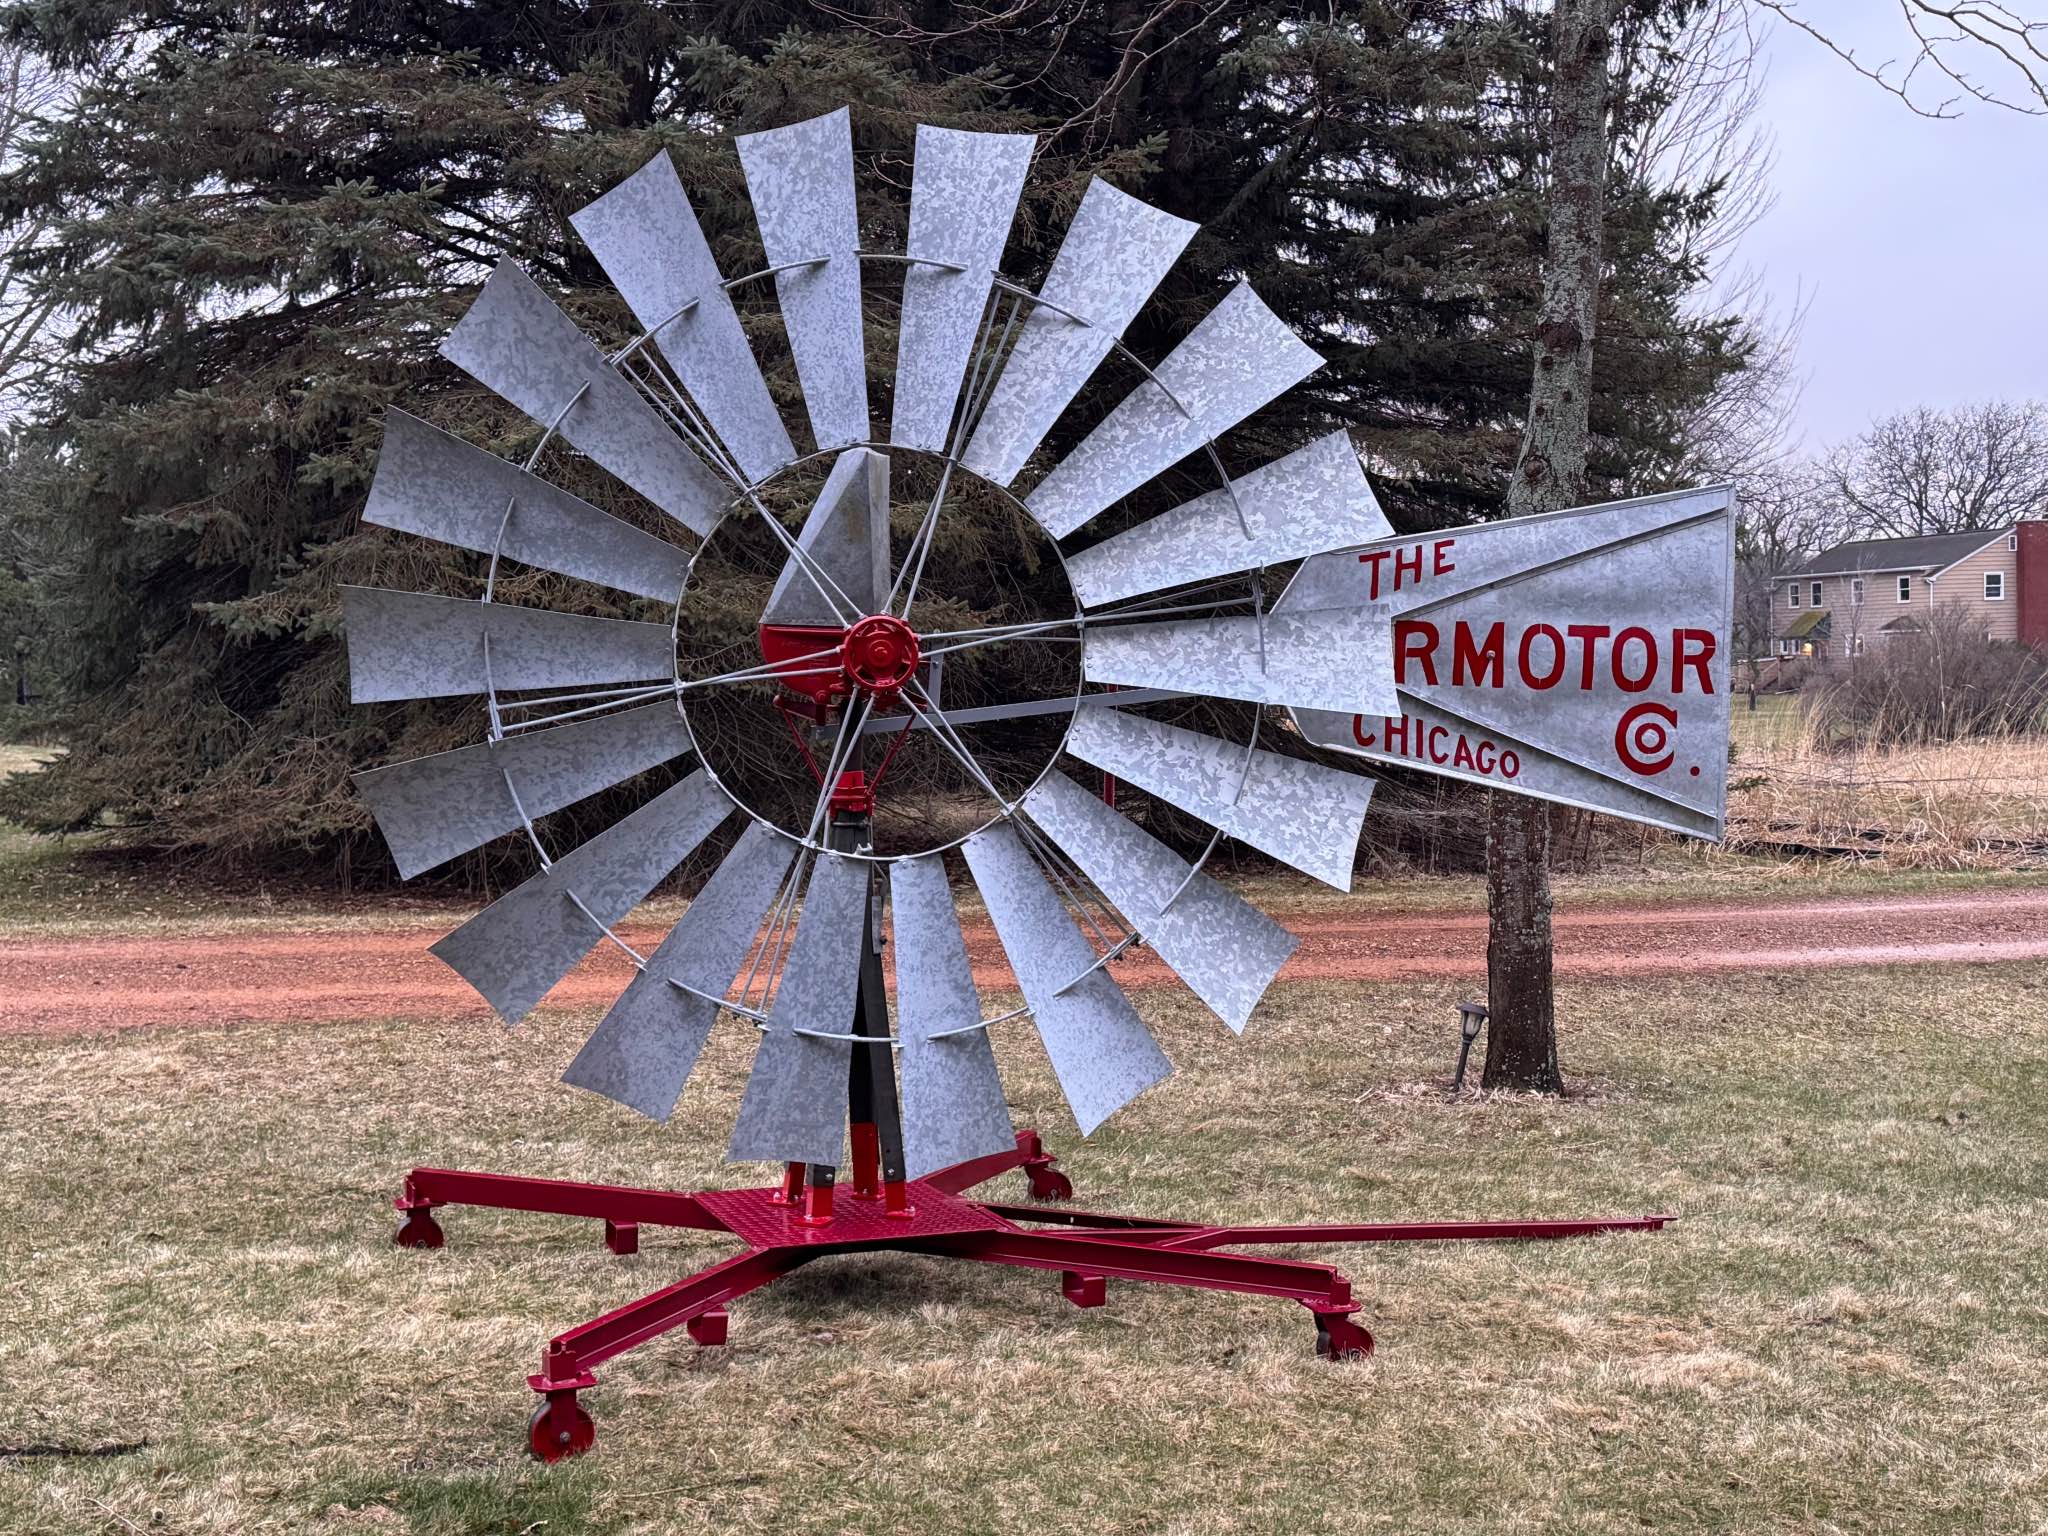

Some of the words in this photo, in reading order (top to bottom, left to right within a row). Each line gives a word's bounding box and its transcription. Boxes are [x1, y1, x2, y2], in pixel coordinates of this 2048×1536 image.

[1358, 539, 1456, 601] THE
[1393, 619, 1717, 695] RMOTOR
[1352, 713, 1521, 779] CHICAGO
